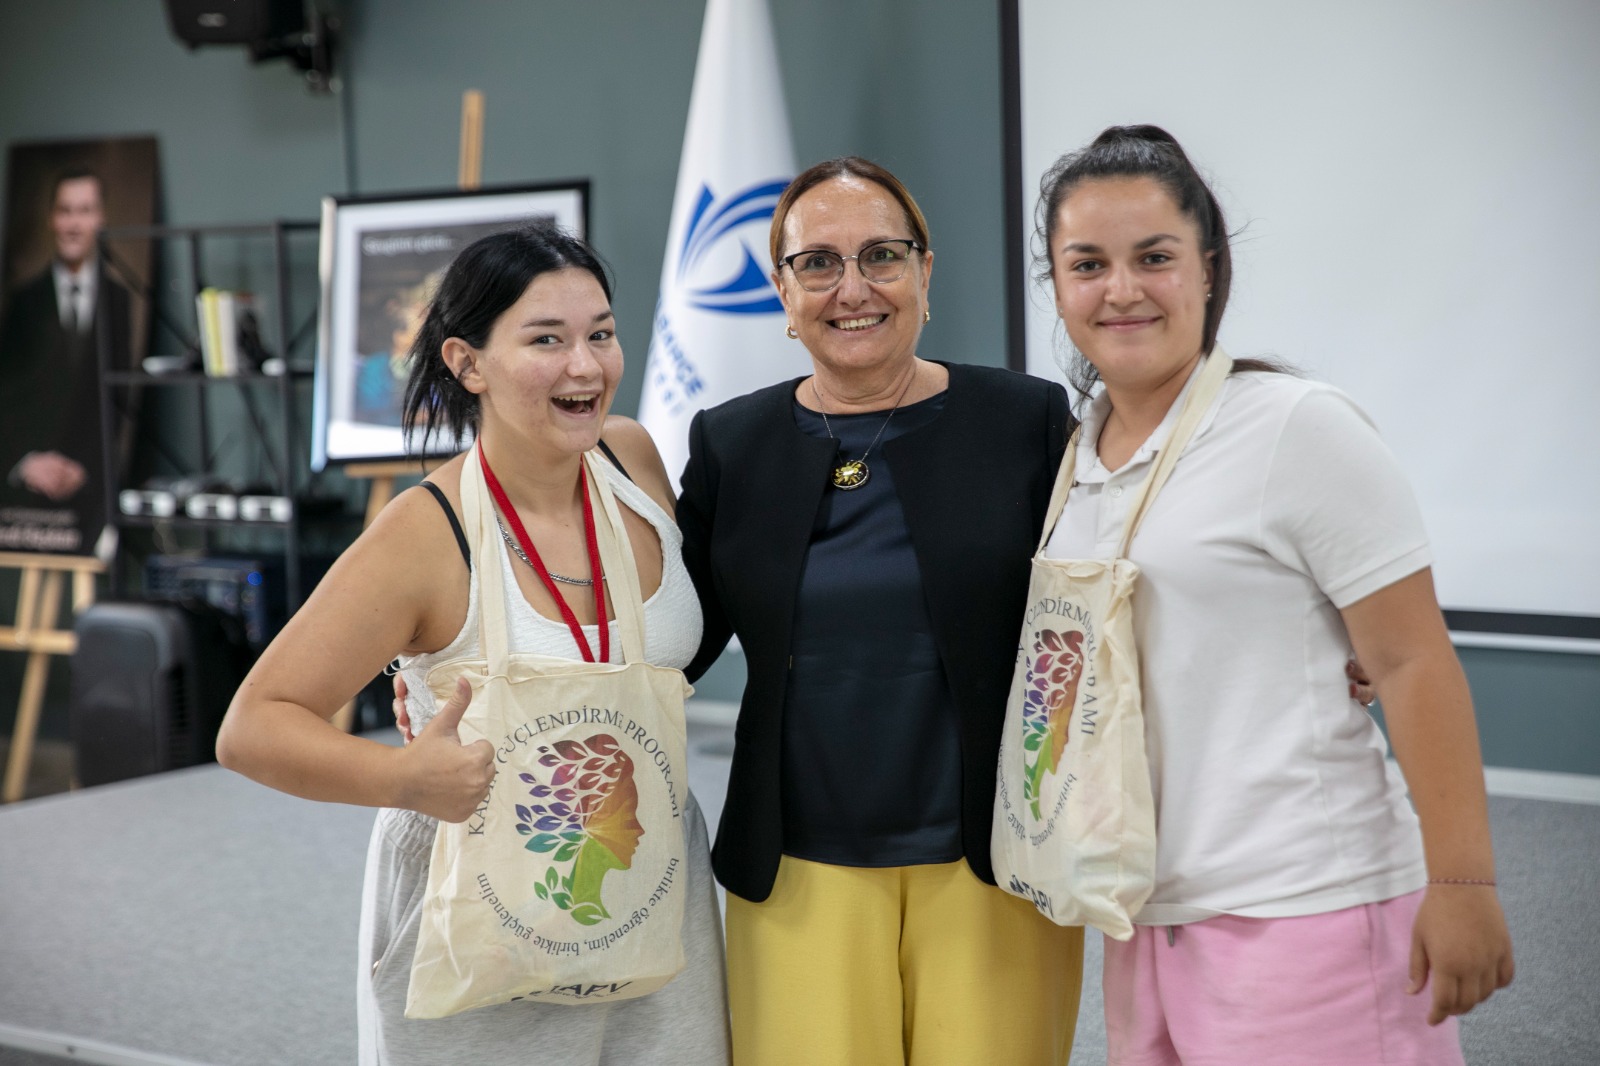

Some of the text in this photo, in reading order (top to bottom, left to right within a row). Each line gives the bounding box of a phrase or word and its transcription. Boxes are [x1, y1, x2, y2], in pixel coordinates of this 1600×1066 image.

[477, 857, 680, 956] birlikte öğrenelim, birlikte güçlenelim
